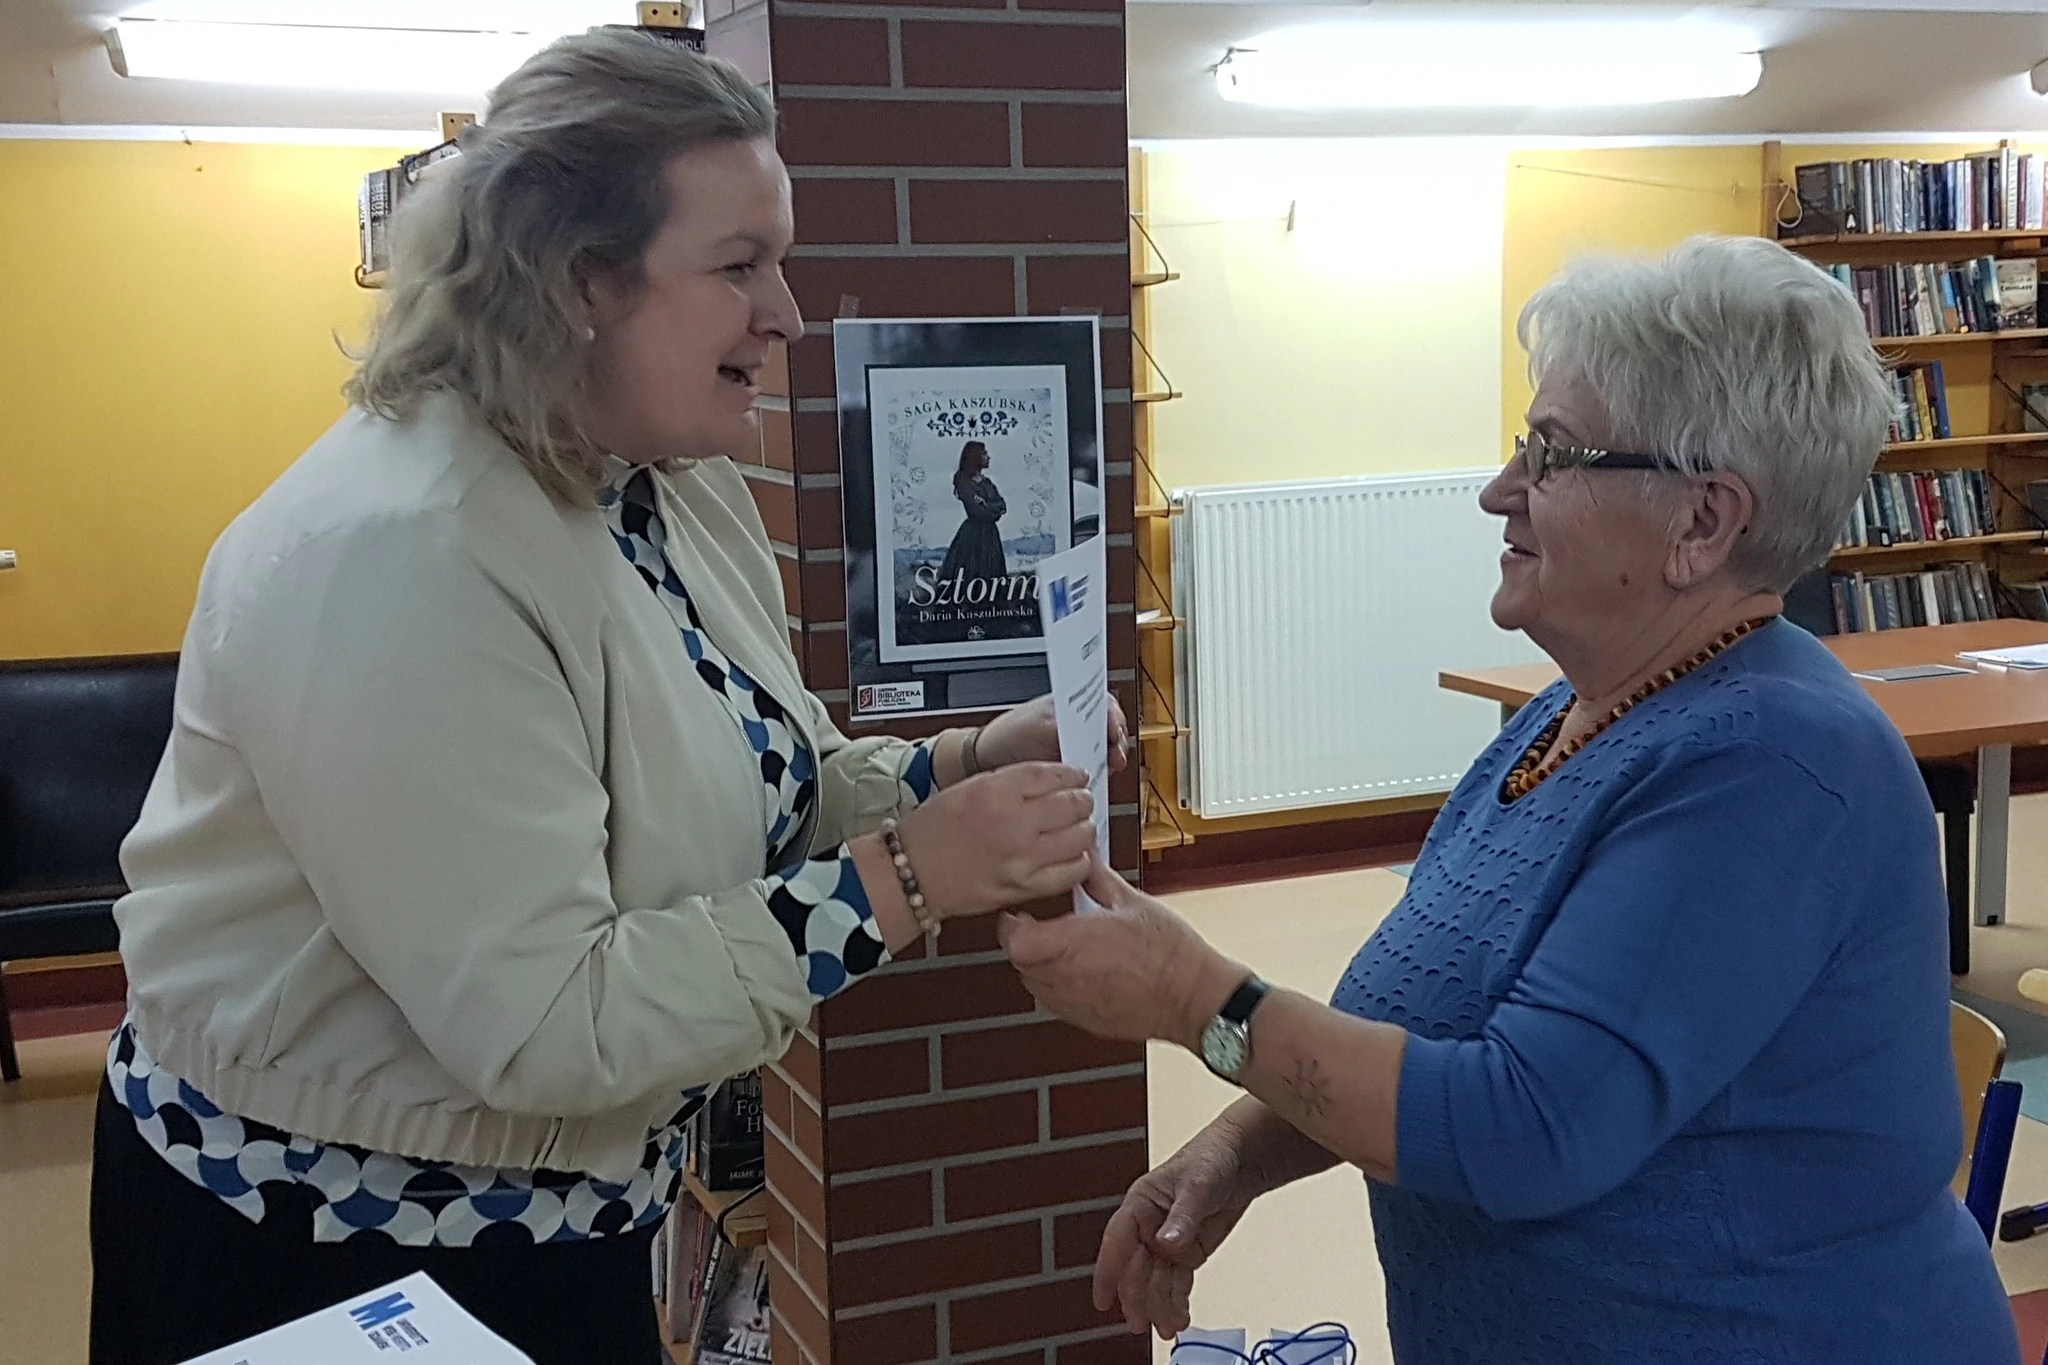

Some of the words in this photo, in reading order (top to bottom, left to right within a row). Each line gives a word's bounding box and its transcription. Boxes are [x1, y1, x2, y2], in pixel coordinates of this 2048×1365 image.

[904, 401, 942, 418] SAGA
[949, 398, 1036, 414] KASZUBSKA
[908, 565, 1040, 607] Sztorm
[919, 609, 952, 624] Daria
[957, 605, 1034, 621] Kaszubowska
[877, 690, 921, 698] BIBLIOTEKA
